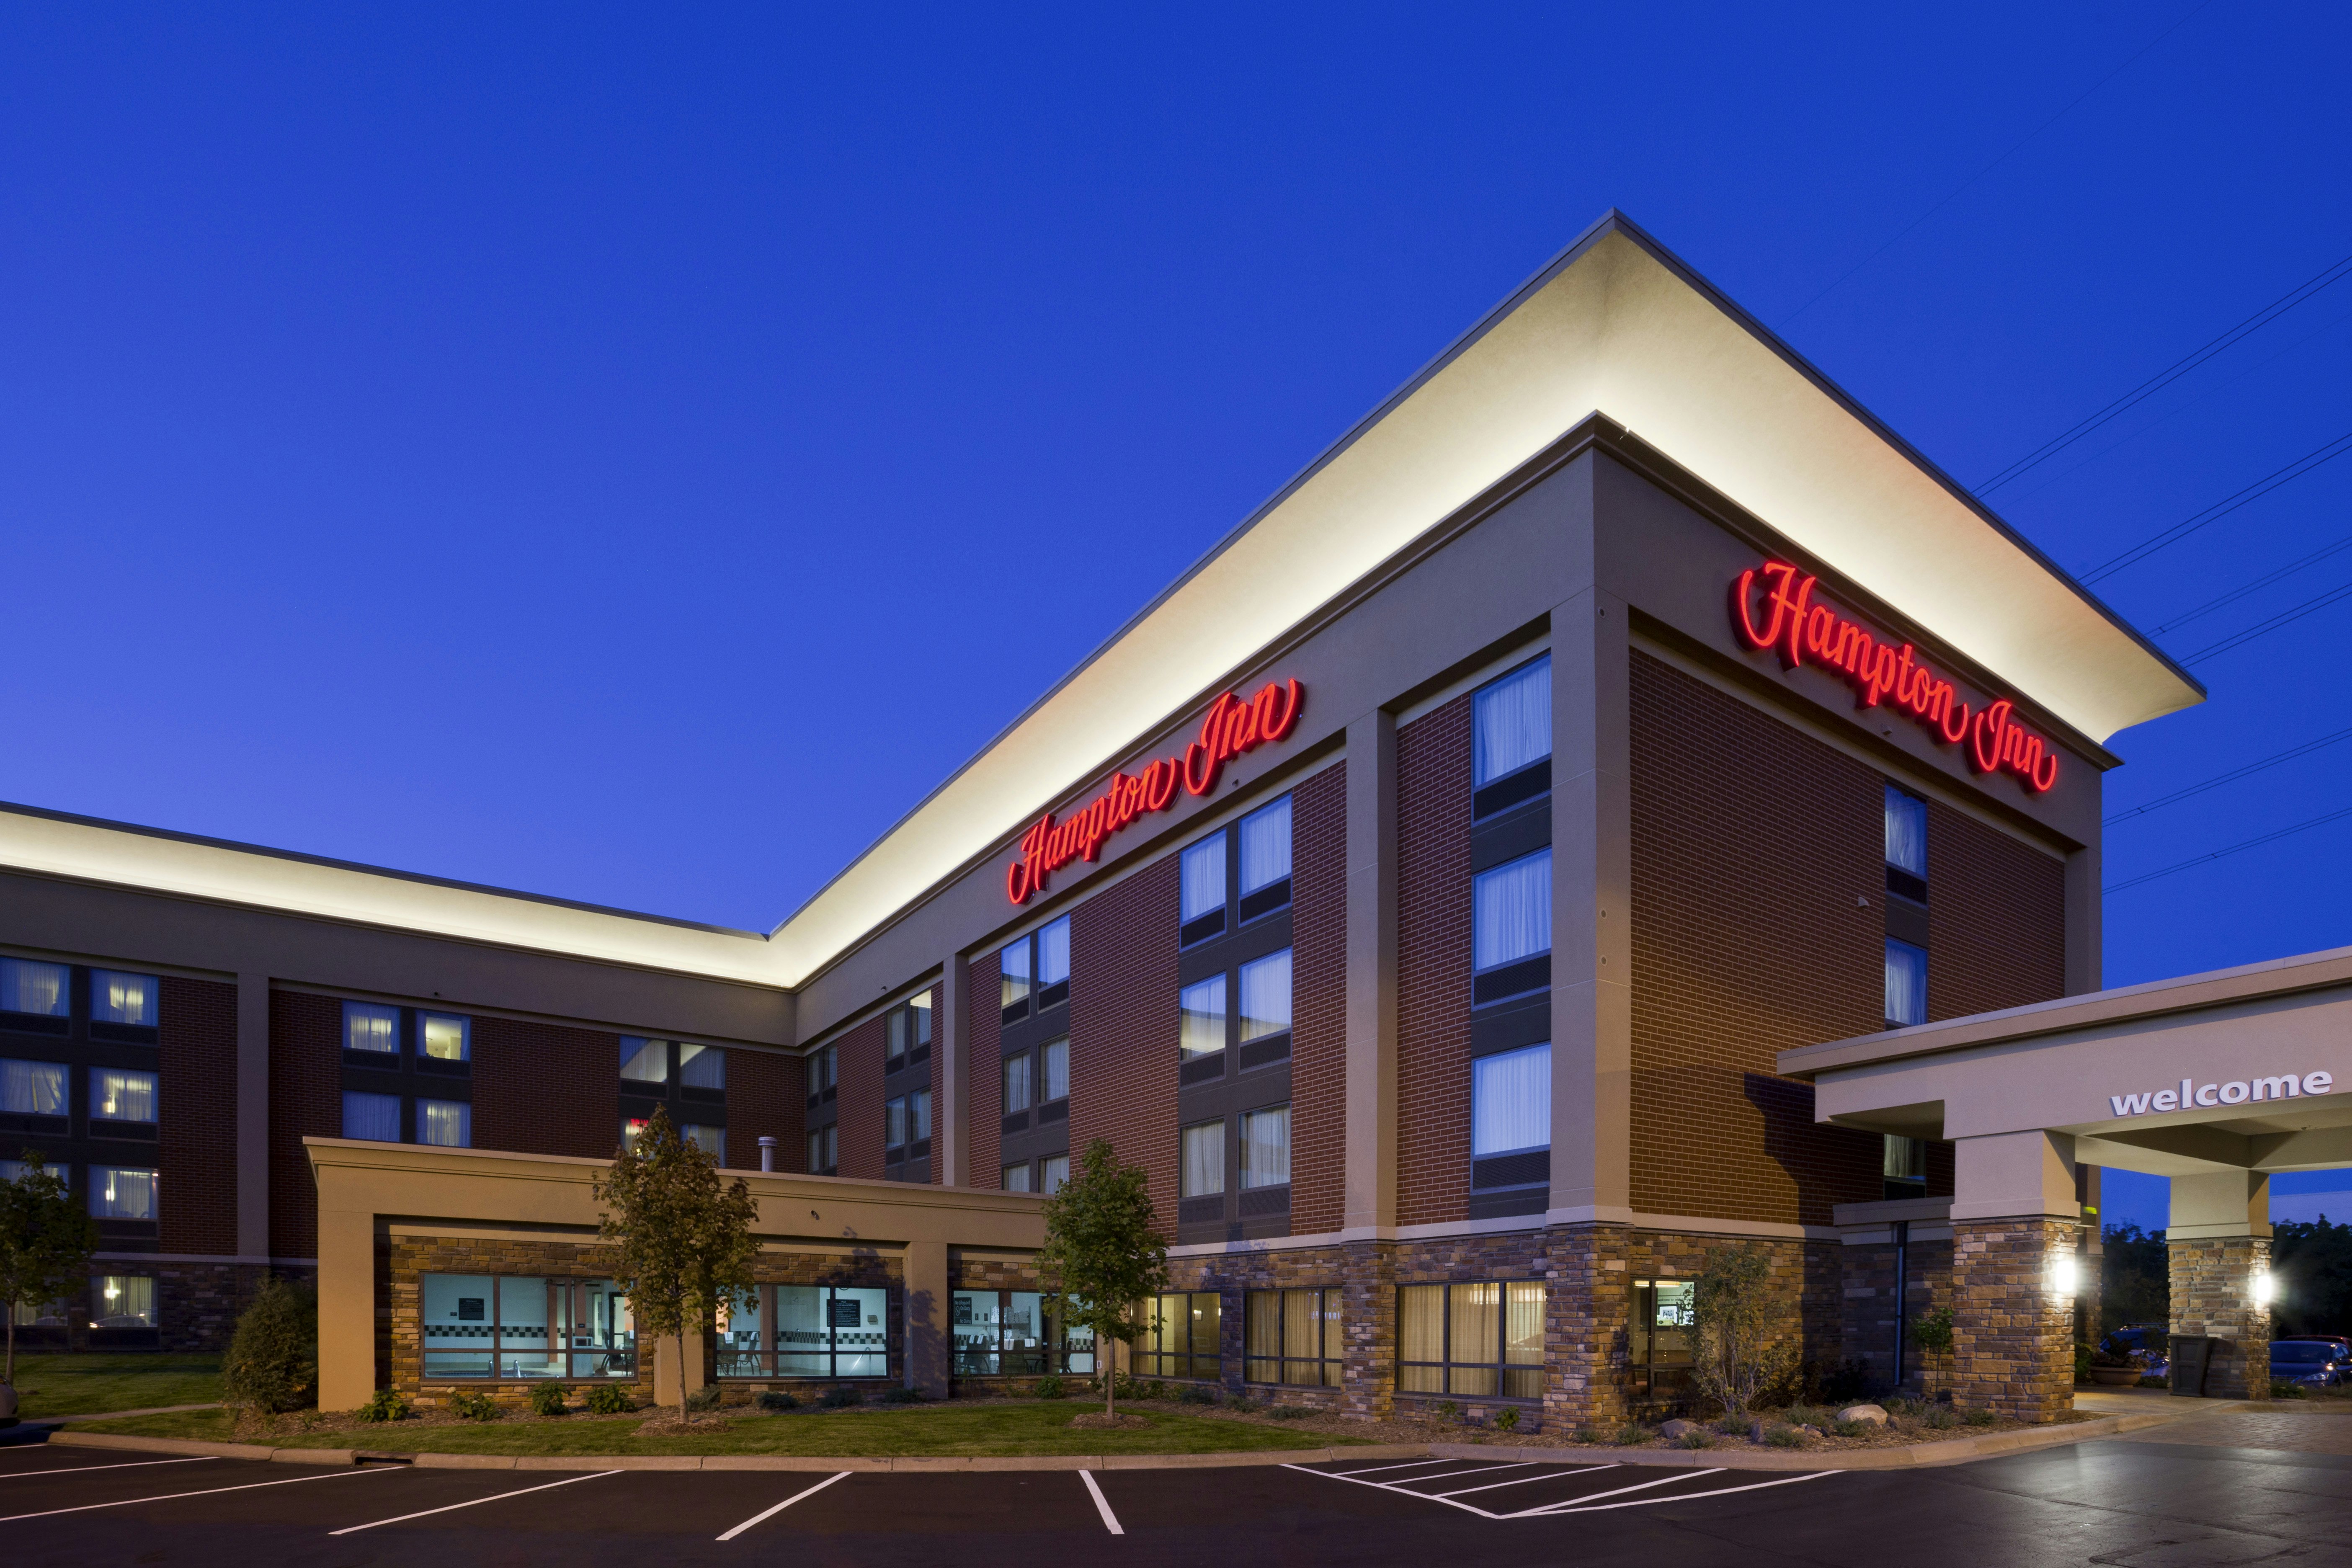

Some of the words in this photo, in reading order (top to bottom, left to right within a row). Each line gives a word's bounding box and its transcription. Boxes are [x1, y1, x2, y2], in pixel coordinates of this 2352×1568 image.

[1730, 562, 1969, 743] Hampton
[1968, 701, 2057, 793] Inn
[1008, 757, 1184, 904] Hampton
[1184, 678, 1305, 795] Inn
[2110, 1070, 2333, 1117] welcome
